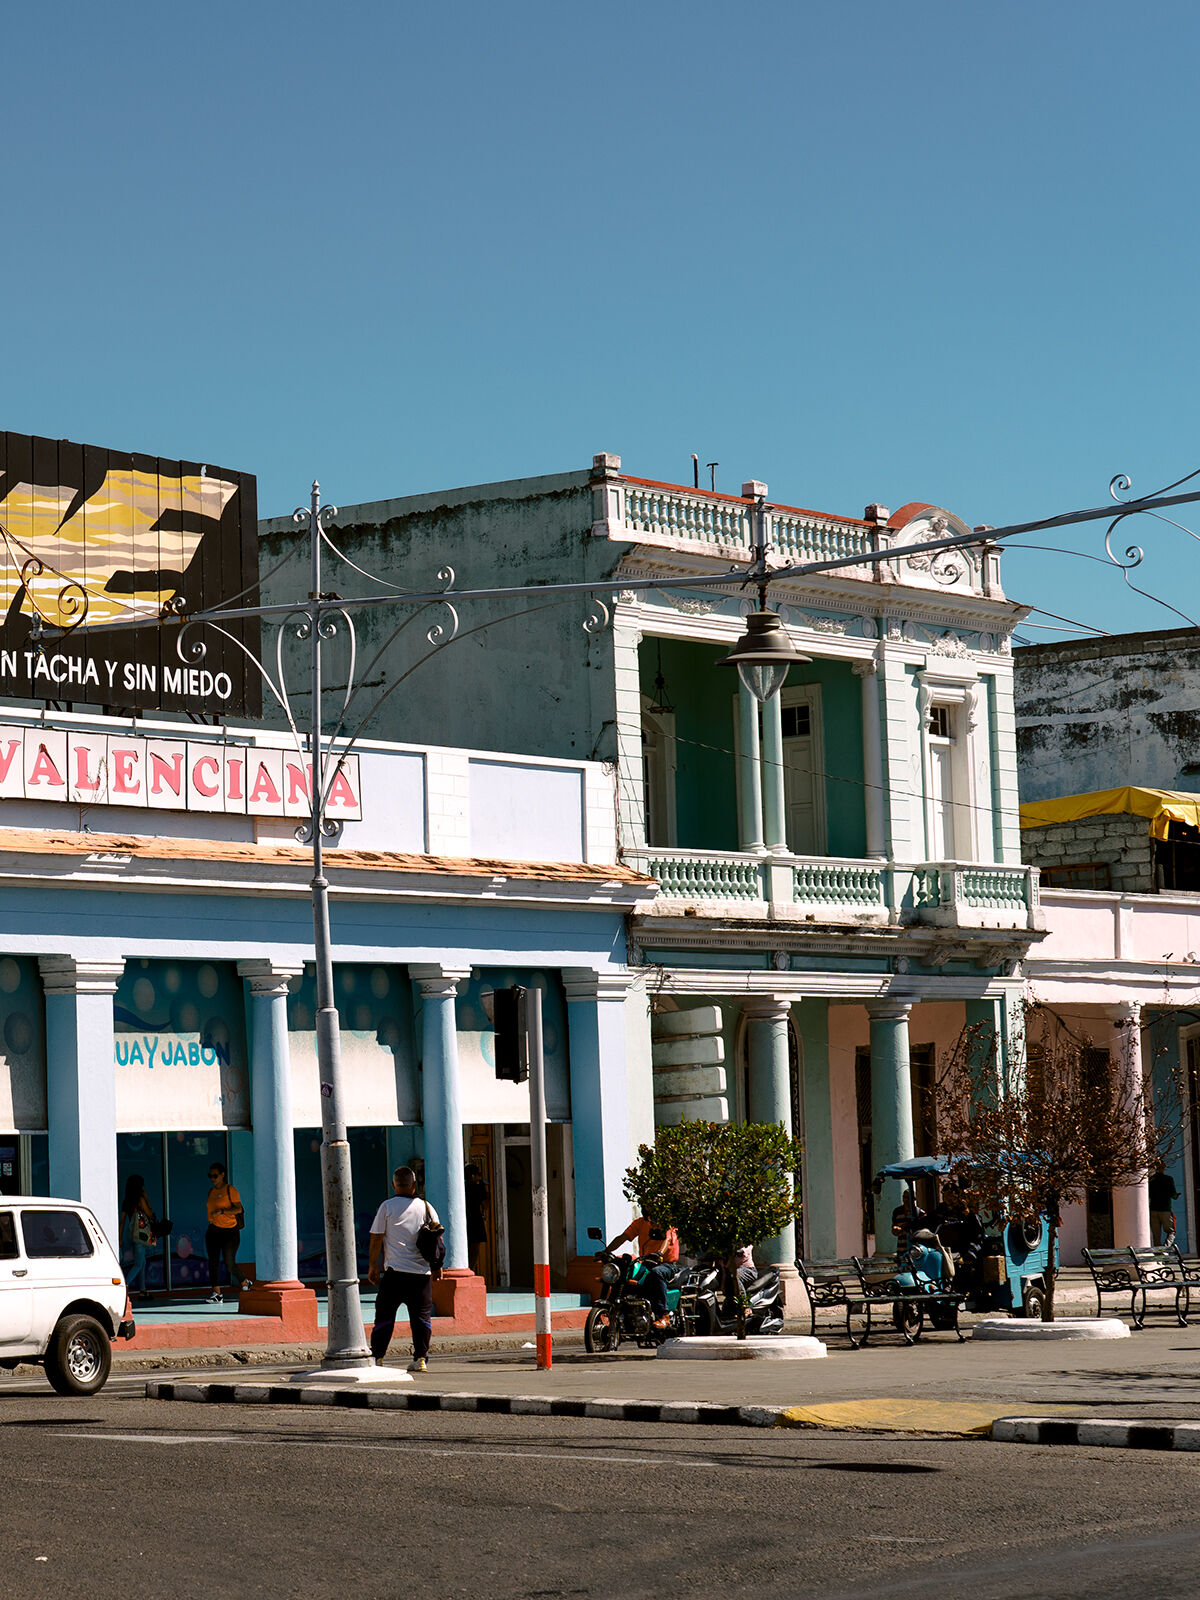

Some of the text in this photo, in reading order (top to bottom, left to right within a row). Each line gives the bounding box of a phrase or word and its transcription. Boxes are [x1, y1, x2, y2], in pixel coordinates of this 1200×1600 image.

[24, 651, 100, 686] TACHA
[104, 659, 118, 688] Y
[123, 662, 157, 692] SIN
[163, 666, 233, 700] MIEDO
[114, 1040, 144, 1066] UA
[143, 1036, 158, 1068] Y
